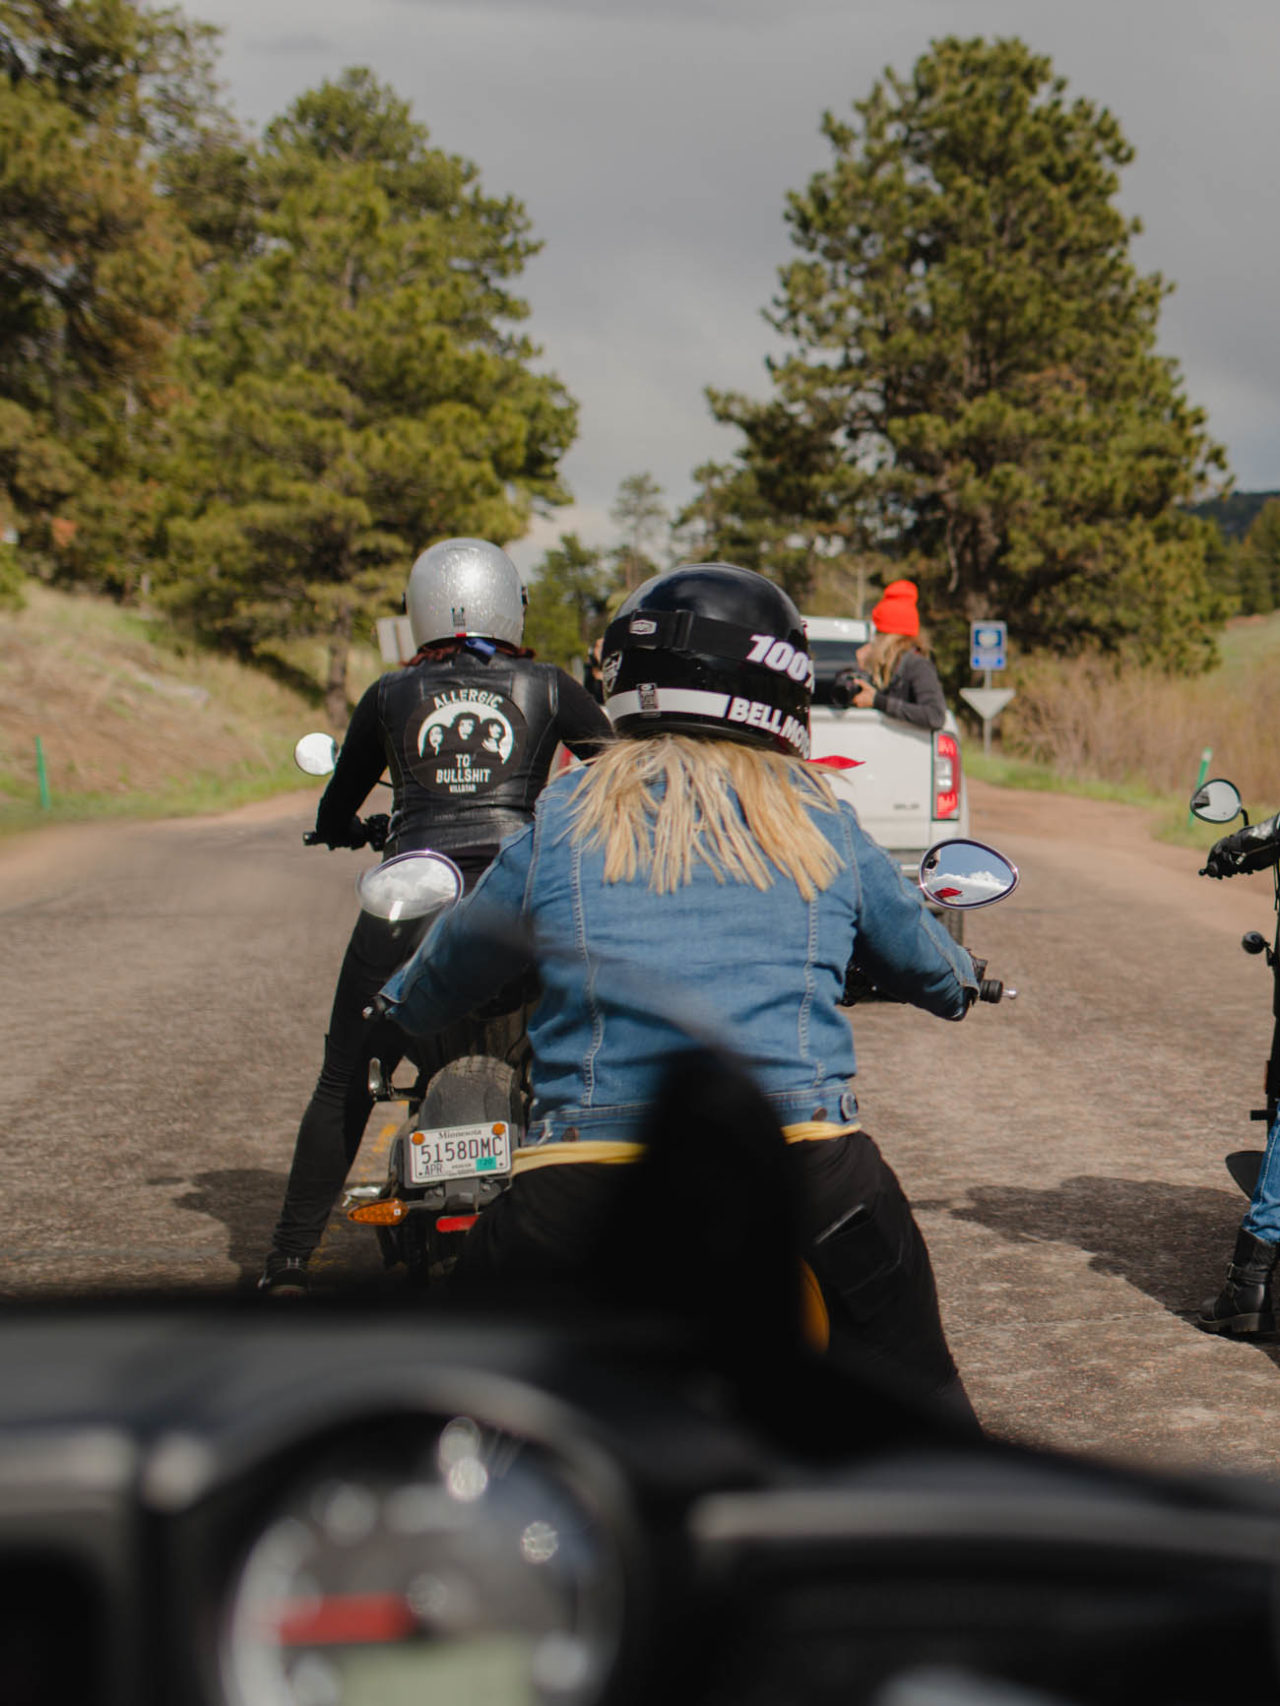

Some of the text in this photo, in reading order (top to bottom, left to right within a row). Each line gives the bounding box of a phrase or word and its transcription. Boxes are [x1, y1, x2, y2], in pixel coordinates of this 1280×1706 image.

[433, 688, 504, 710] ALLERGIC
[727, 697, 782, 734] BELL
[455, 753, 471, 768] TO
[435, 768, 491, 784] BULLSHIT
[438, 1129, 482, 1139] Minnesota
[421, 1136, 503, 1165] 5158DMC
[425, 1164, 443, 1176] APR
